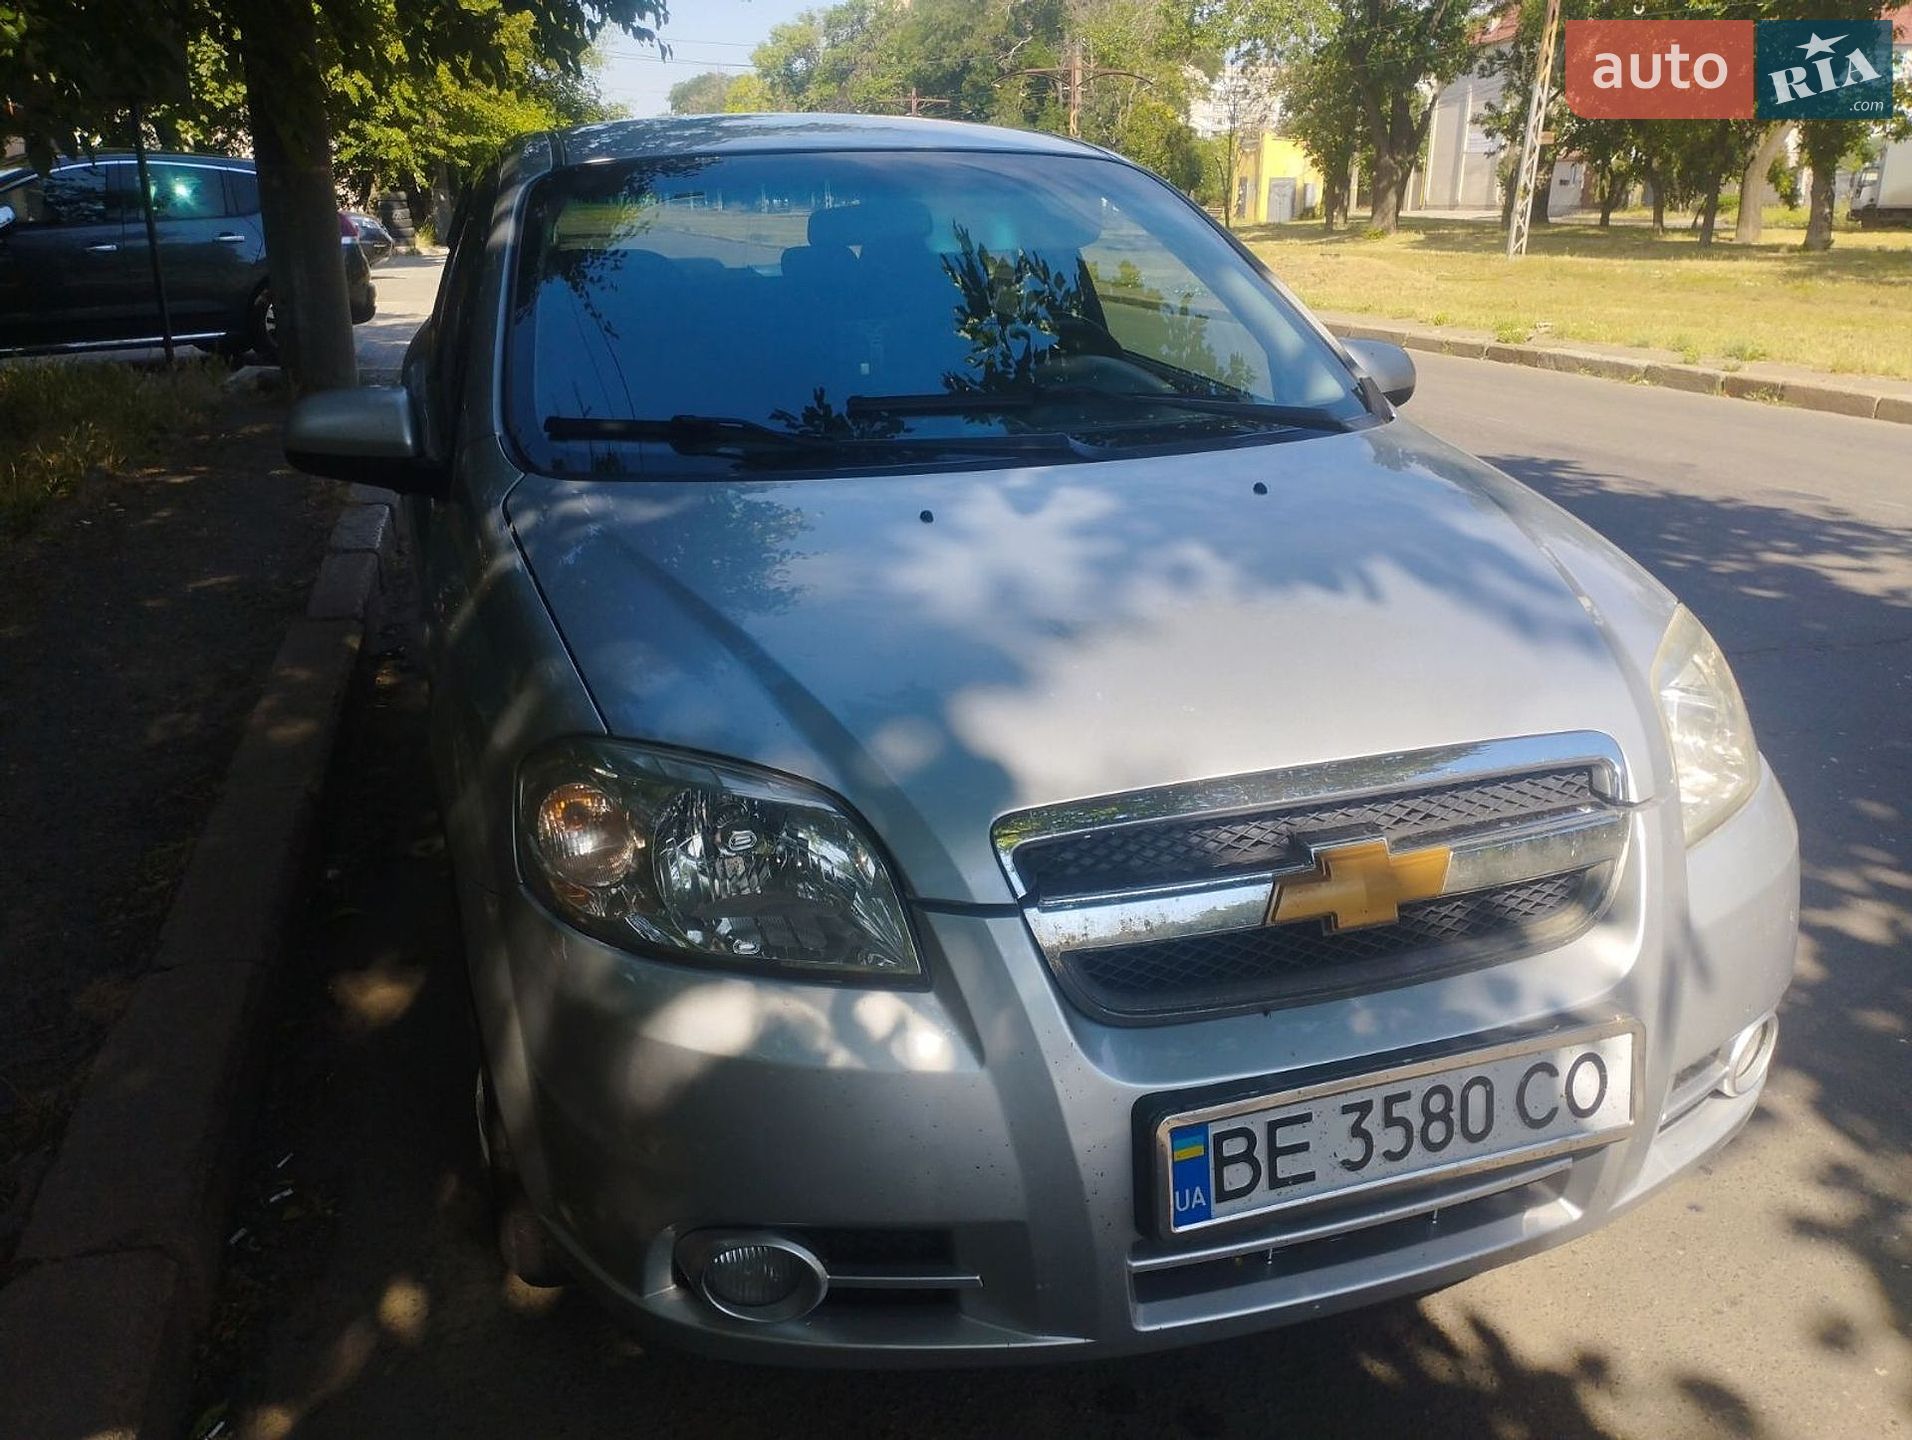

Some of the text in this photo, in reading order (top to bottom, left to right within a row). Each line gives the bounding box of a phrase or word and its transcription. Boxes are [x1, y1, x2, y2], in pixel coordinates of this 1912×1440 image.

[1212, 1051, 1609, 1204] BE 3580 CO
[1174, 1186, 1207, 1213] UA
